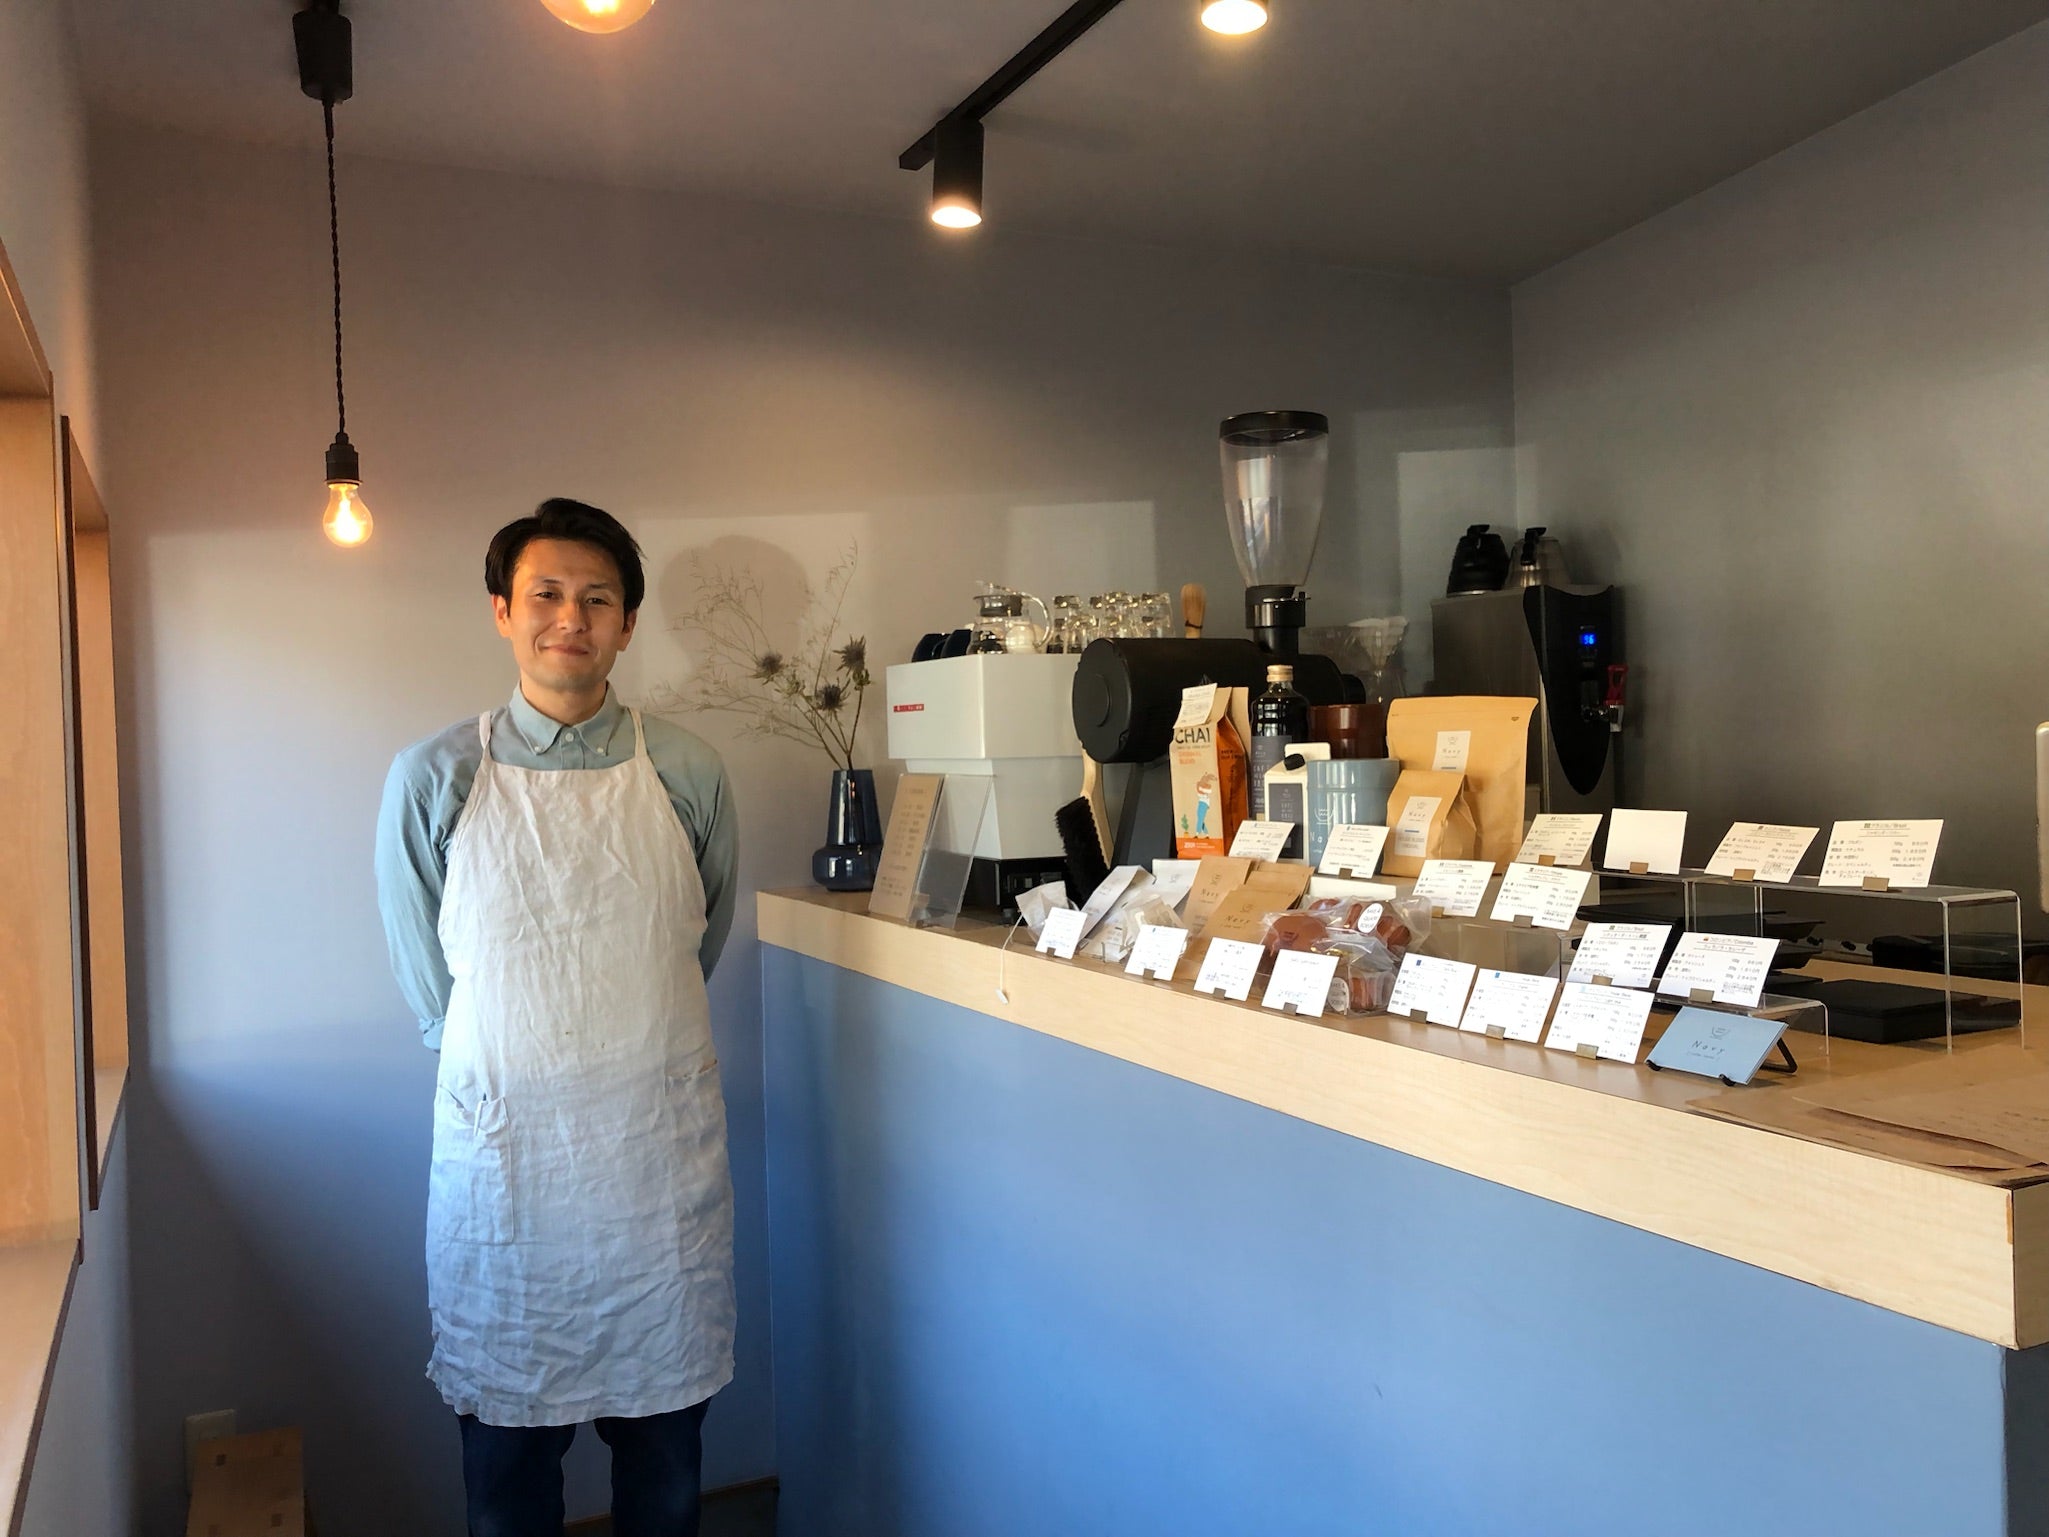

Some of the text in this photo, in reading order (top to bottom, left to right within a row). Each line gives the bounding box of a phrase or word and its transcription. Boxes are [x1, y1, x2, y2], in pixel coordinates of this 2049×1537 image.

[1175, 727, 1211, 744] CHAI
[1310, 831, 1323, 844] Na
[1692, 1040, 1725, 1054] Navy
